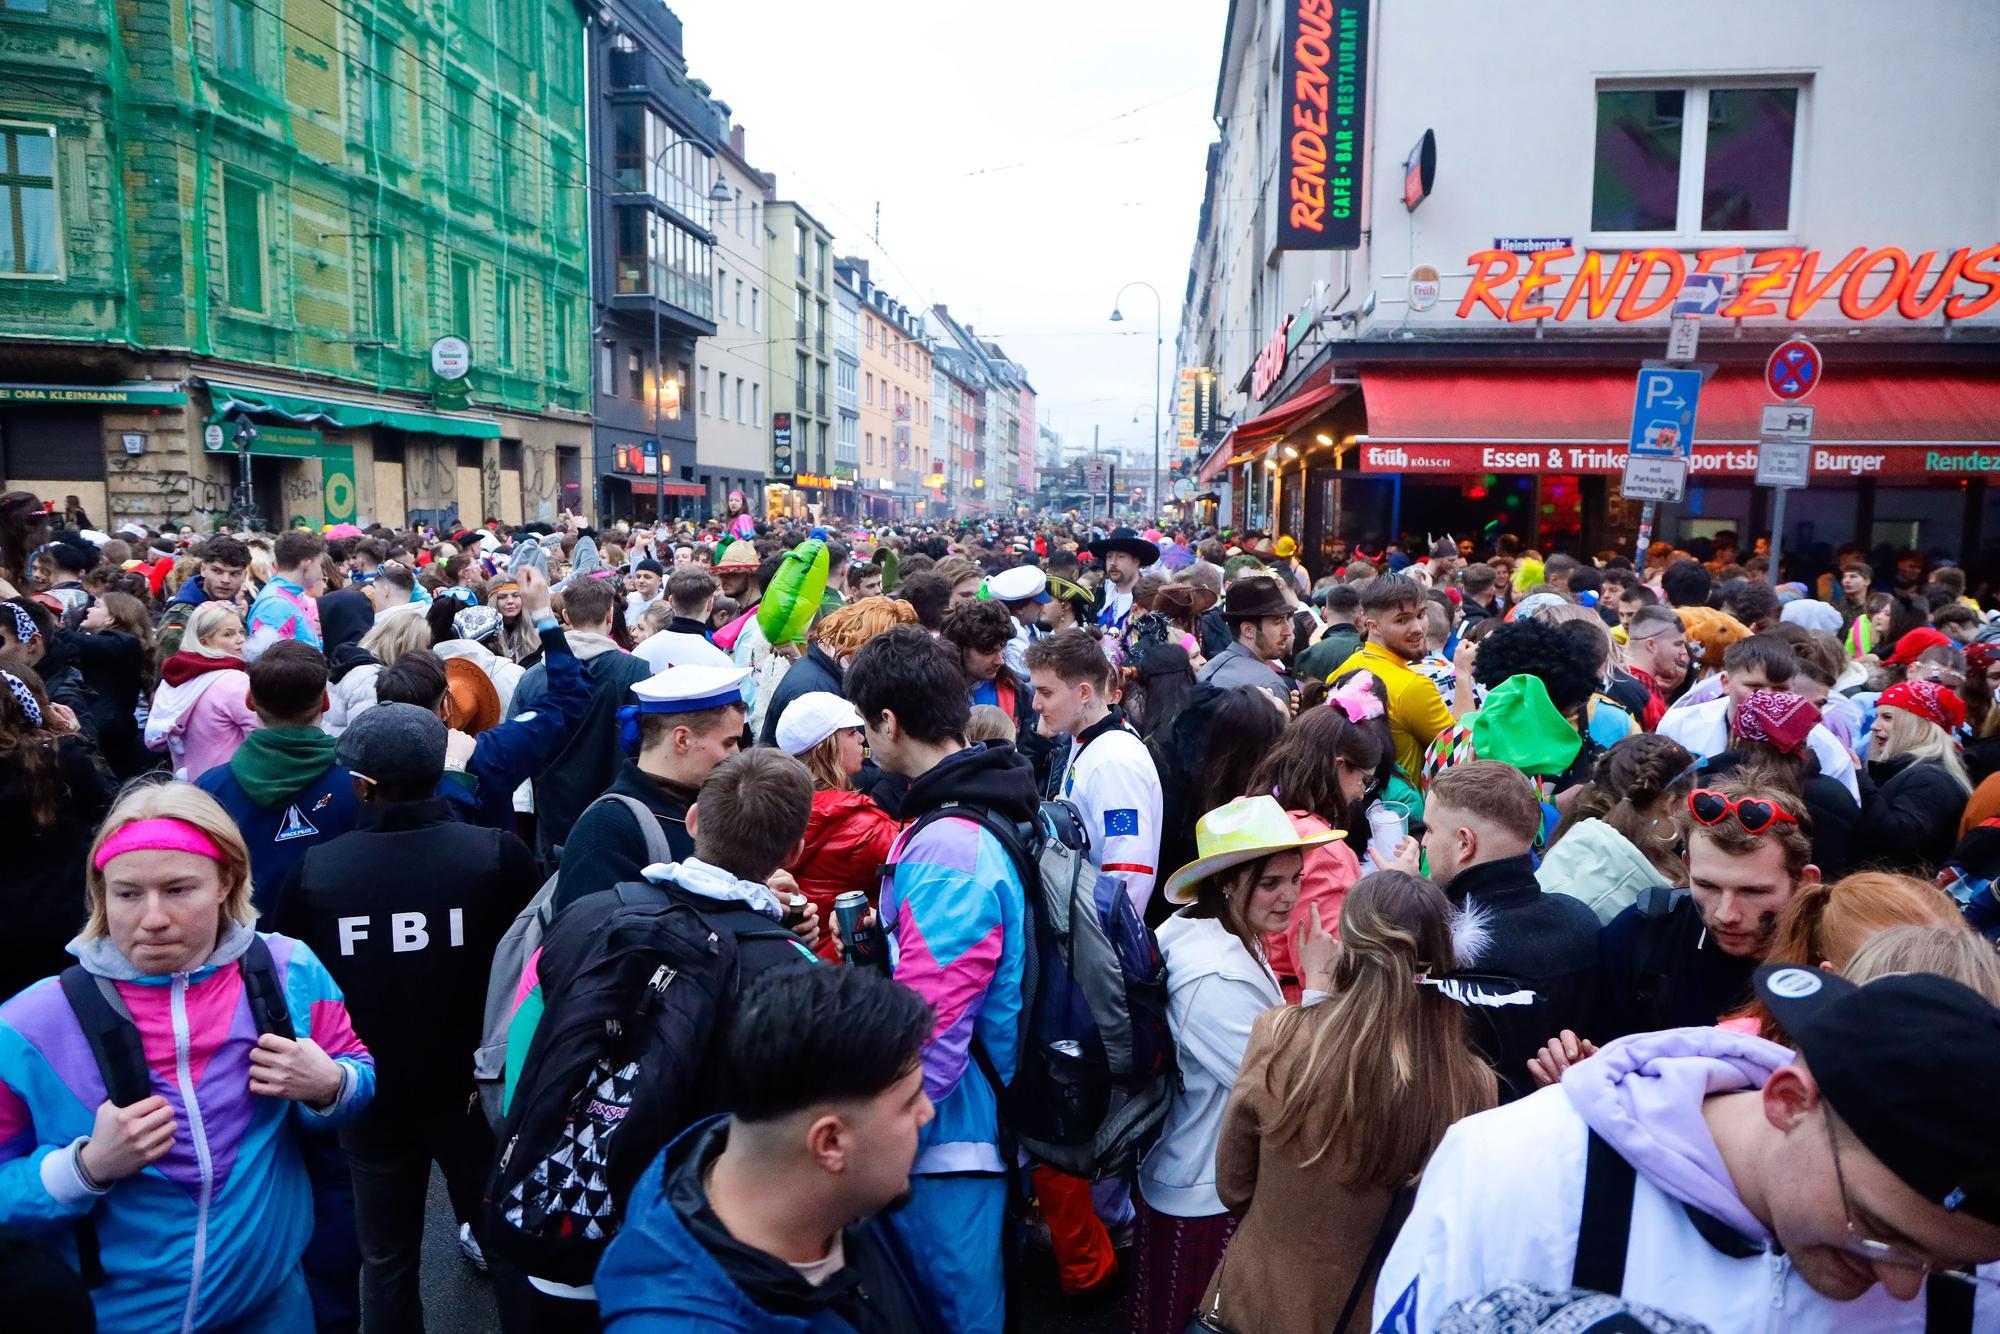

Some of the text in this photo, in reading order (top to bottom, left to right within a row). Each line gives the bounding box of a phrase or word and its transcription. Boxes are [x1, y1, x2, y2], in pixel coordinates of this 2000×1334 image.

[1290, 0, 1334, 233] RENDEZVOUS
[1332, 7, 1358, 219] CAFÉ BAR RESTAURANT
[15, 389, 47, 400] OMA
[50, 390, 128, 402] KLEINMANN
[1645, 375, 1674, 409] P
[1368, 447, 1451, 468] früh KÖLSCH
[1482, 447, 1629, 470] Essen & Trinke
[1681, 449, 1759, 474] portsb
[1814, 450, 1886, 476] Burger
[1926, 450, 2000, 472] Rendez
[1633, 474, 1675, 486] Parkschein
[338, 907, 465, 956] FBI
